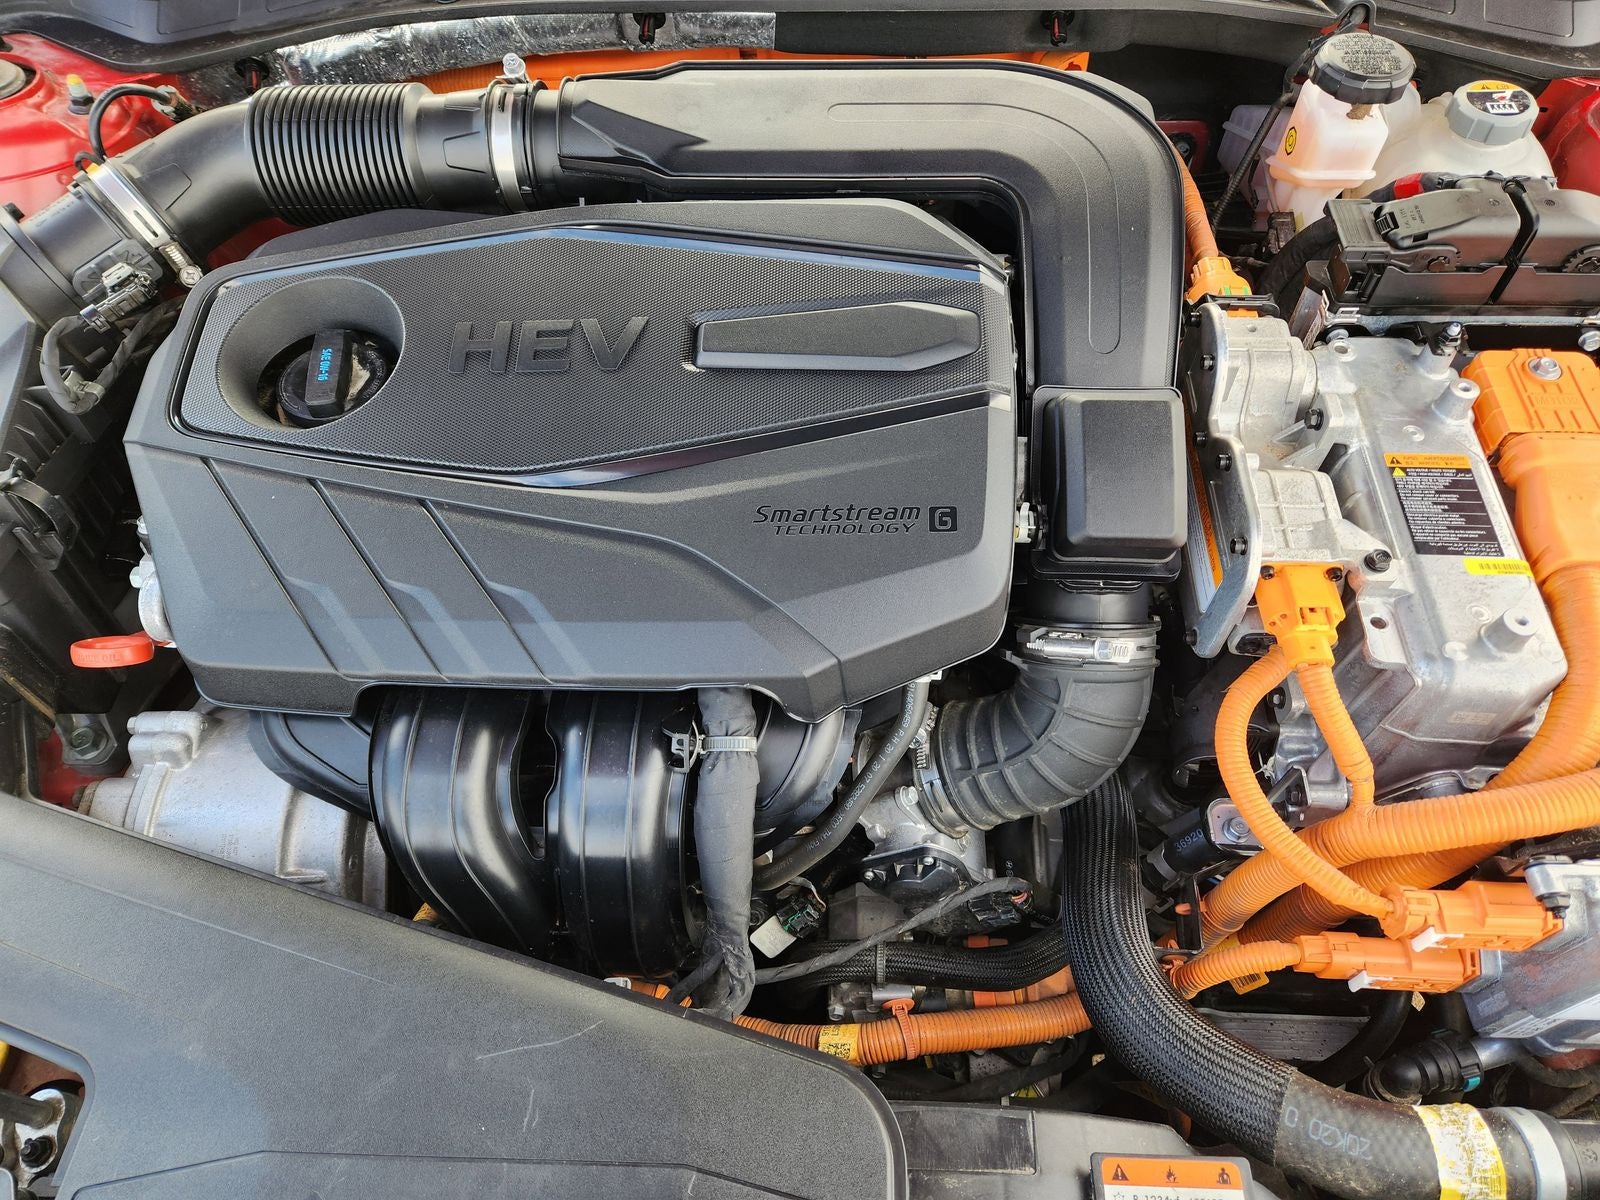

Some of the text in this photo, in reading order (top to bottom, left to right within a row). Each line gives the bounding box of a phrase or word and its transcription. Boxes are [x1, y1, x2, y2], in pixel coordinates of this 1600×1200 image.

[320, 348, 332, 360] SAE
[448, 315, 649, 374] HEV
[753, 503, 920, 523] Smartstream
[773, 522, 915, 536] TECHNOLOGY
[1174, 828, 1203, 852] 36920
